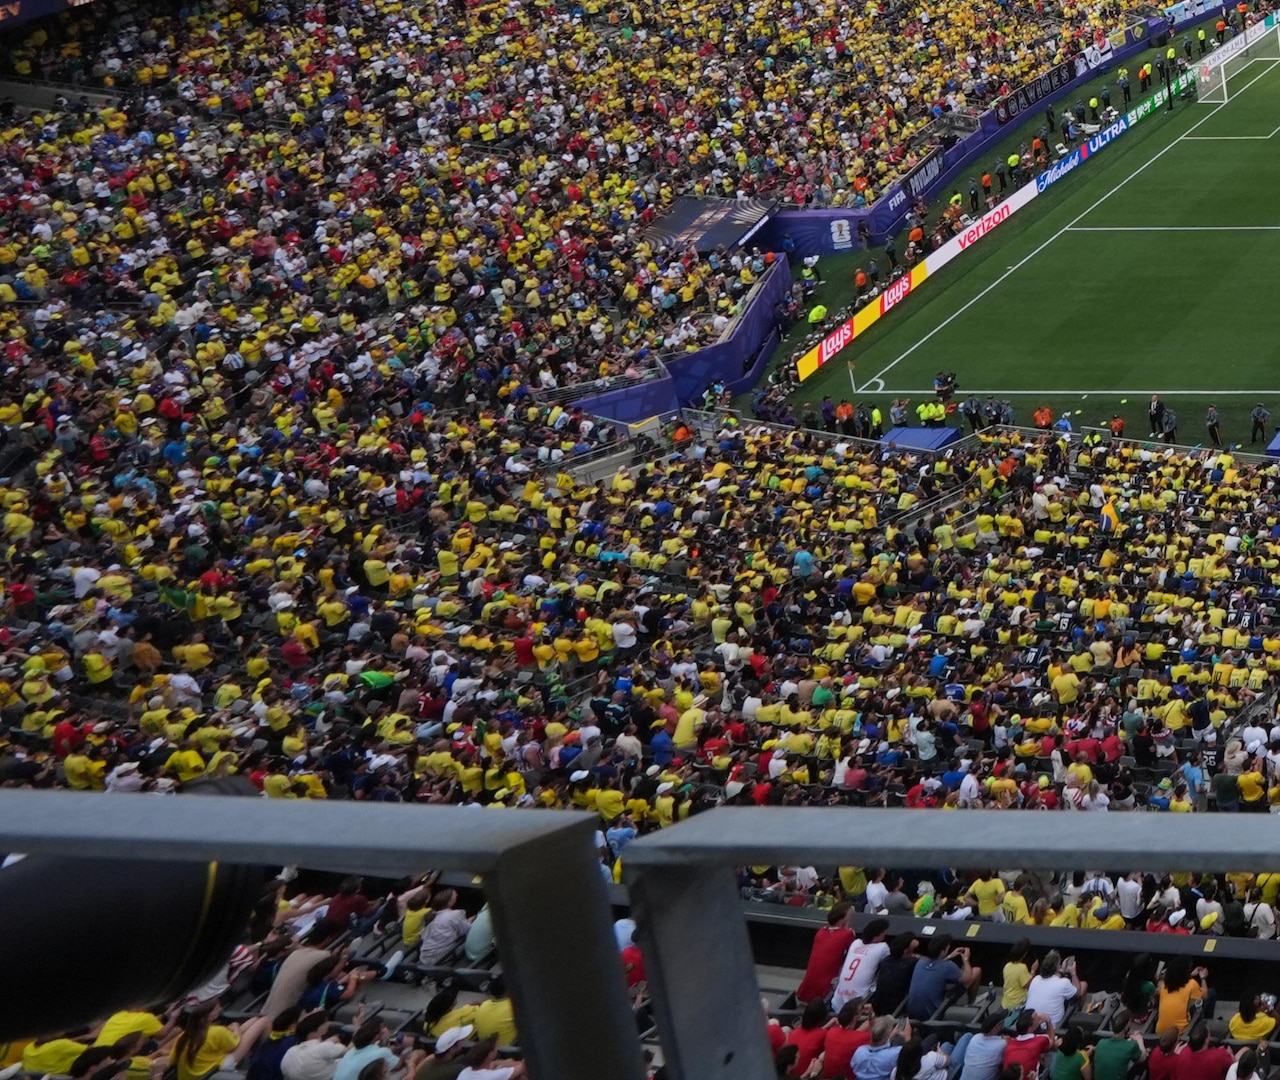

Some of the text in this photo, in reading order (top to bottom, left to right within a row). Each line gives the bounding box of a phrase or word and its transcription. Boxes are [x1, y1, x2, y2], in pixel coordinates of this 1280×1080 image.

[1037, 118, 1128, 193] Michelob ULTRA
[888, 189, 907, 211] FIFA
[957, 203, 1011, 249] verizon
[882, 276, 910, 312] Lay's
[821, 322, 852, 360] Lay's
[844, 957, 861, 981] 9
